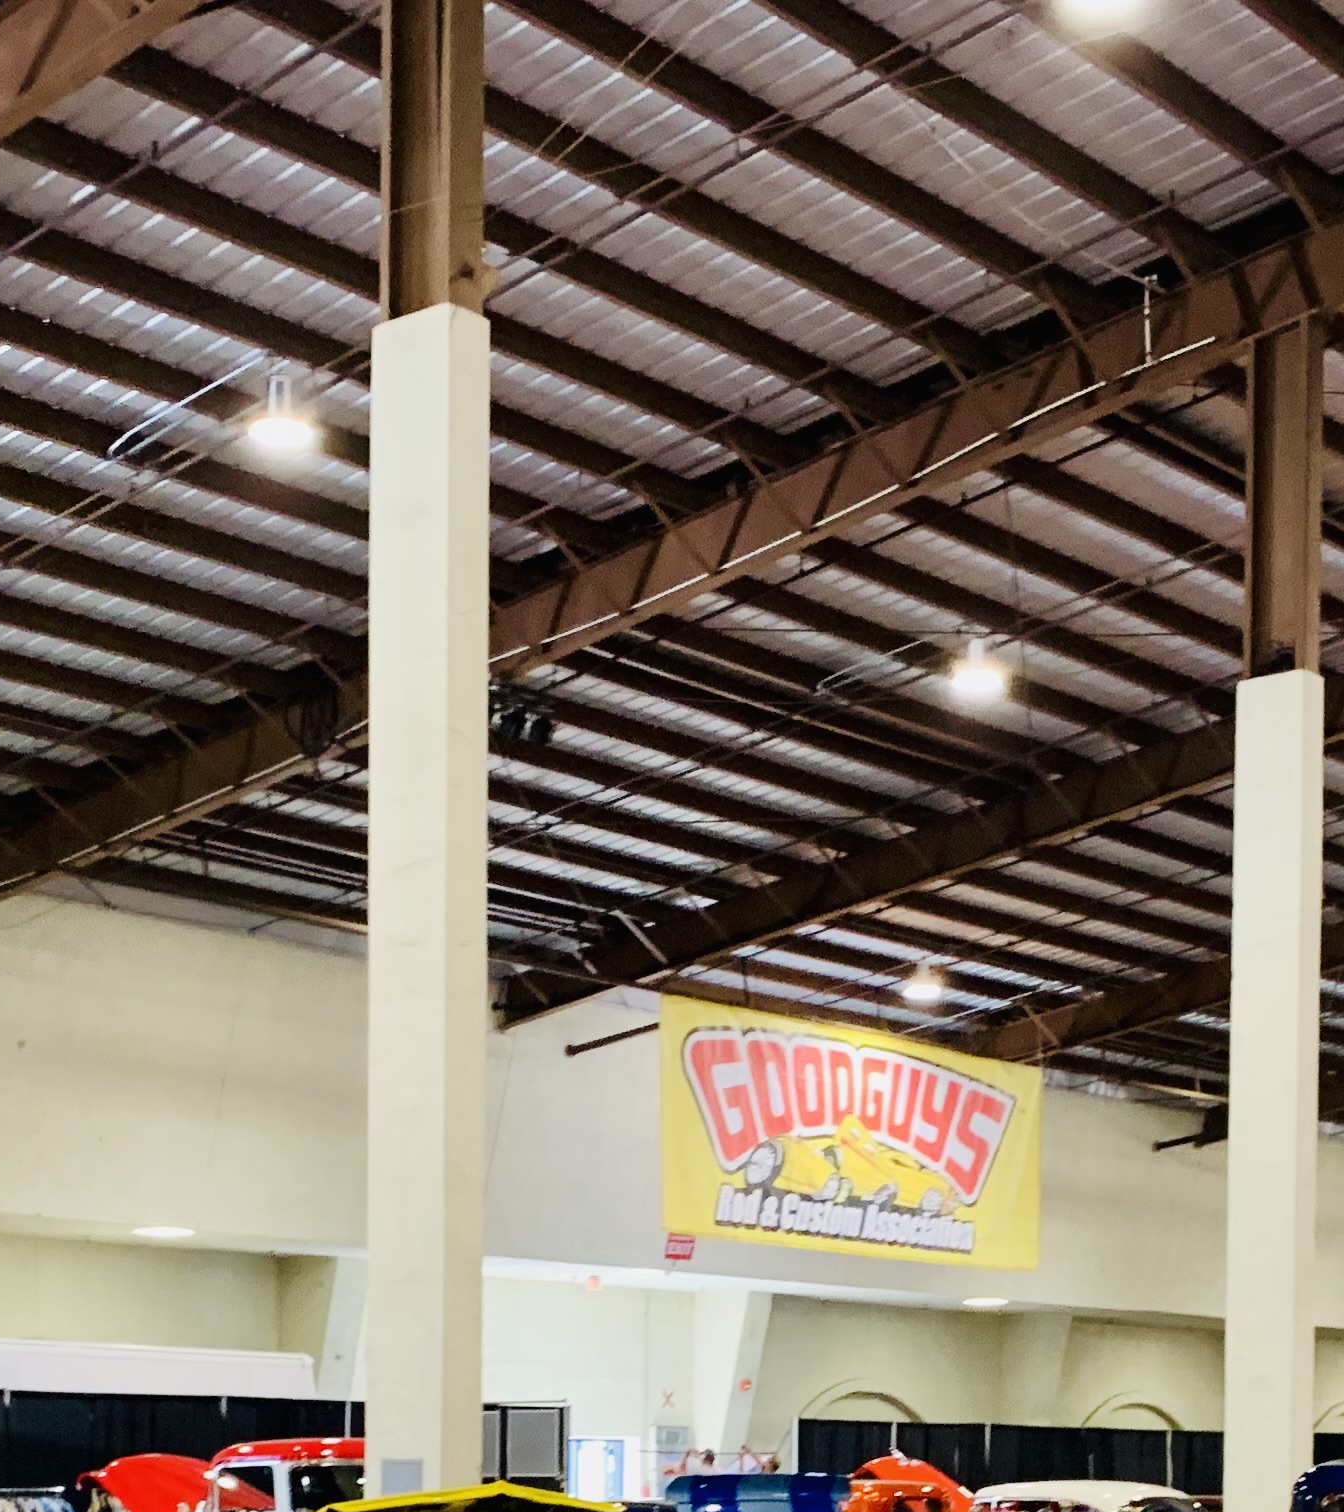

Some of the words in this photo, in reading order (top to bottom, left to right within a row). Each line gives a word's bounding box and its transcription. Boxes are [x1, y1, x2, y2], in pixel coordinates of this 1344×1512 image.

[687, 1035, 1010, 1199] GOODGUYS
[760, 1196, 780, 1230] &
[780, 1192, 863, 1239] Custom
[862, 1204, 974, 1252] Association
